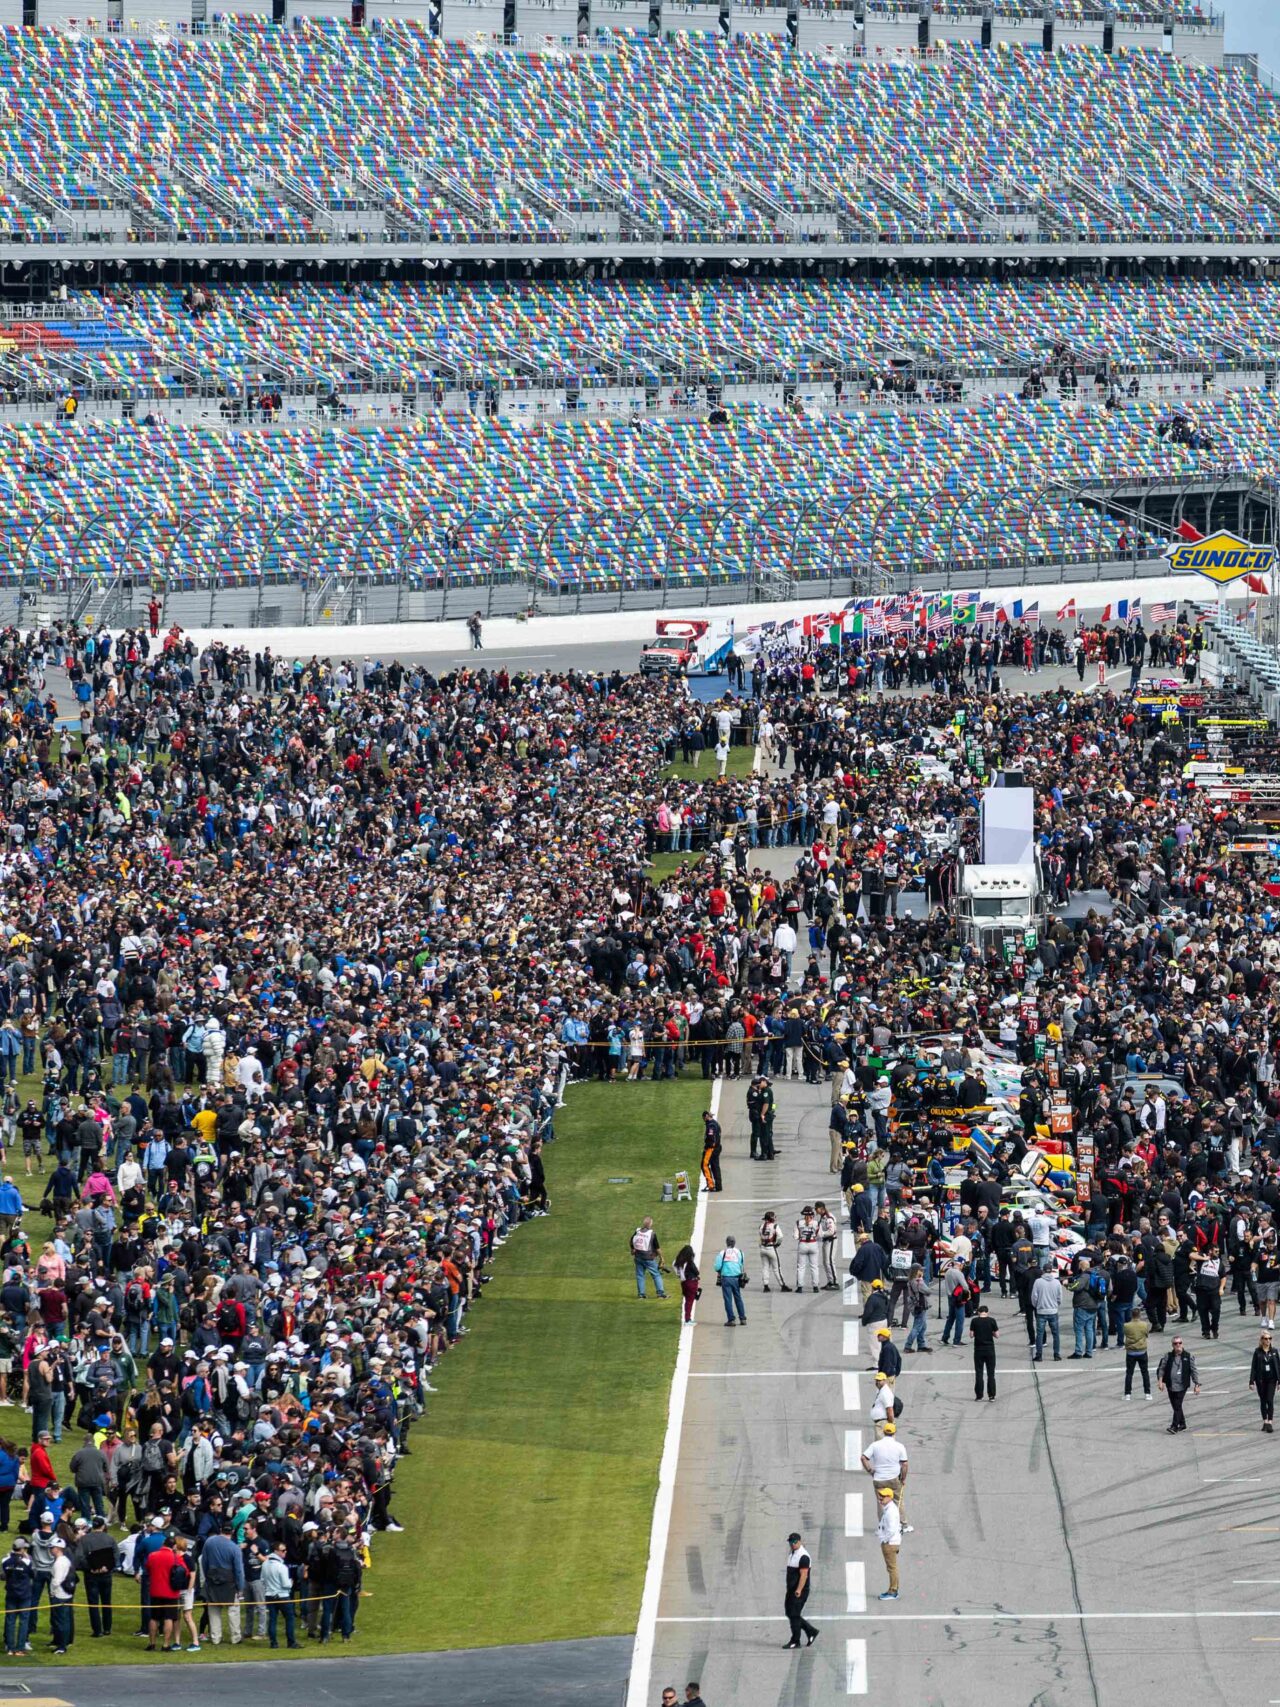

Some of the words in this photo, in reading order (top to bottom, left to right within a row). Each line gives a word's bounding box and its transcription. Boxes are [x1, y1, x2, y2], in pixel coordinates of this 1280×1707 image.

[1175, 550, 1273, 568] SUNOCO
[1025, 938, 1035, 947] 27
[1014, 965, 1023, 974] 14
[1029, 1021, 1037, 1031] 79
[930, 1108, 957, 1116] ORLANDO
[1055, 1116, 1068, 1127] 74
[1079, 1185, 1089, 1197] 33
